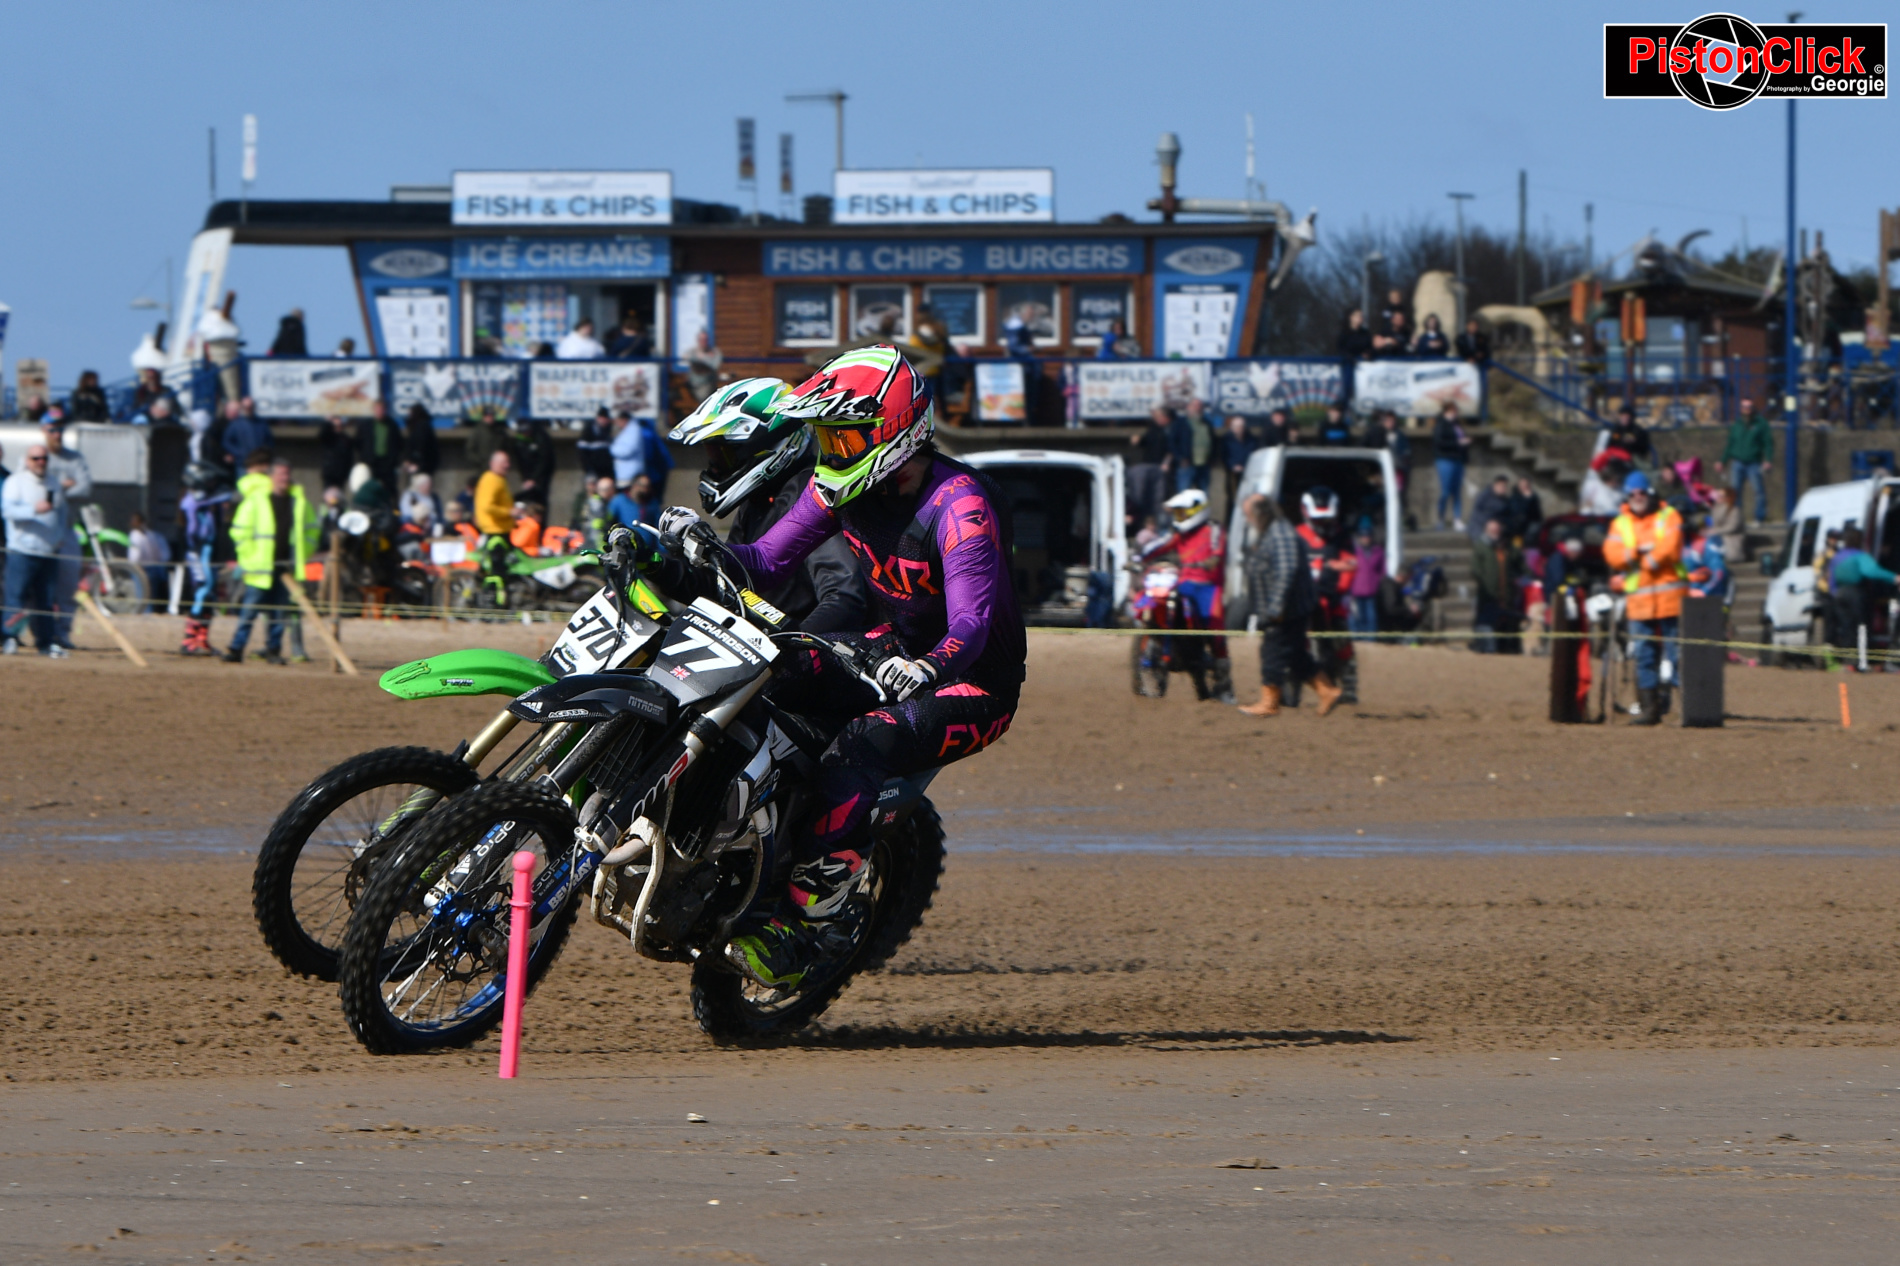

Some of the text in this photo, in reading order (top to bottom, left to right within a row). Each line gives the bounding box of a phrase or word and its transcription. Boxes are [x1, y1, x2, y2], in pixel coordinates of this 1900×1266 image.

[466, 195, 656, 217] FISH & CHIPS
[848, 193, 1038, 215] FISH & CHIPS
[469, 243, 654, 268] ICE CREAMS
[771, 246, 964, 272] FISH & CHIPS
[985, 246, 1130, 270] BURGERS
[785, 301, 828, 316] FISH
[1080, 299, 1122, 315] FISH
[536, 368, 609, 383] WAFFLES
[1085, 367, 1156, 382] WAFFLES
[869, 394, 928, 445] 100%
[913, 419, 928, 440] BELL
[566, 605, 628, 661] 370
[689, 615, 761, 666] RICHARDSON
[660, 626, 744, 673] 77
[534, 723, 574, 765] CIRCUIT
